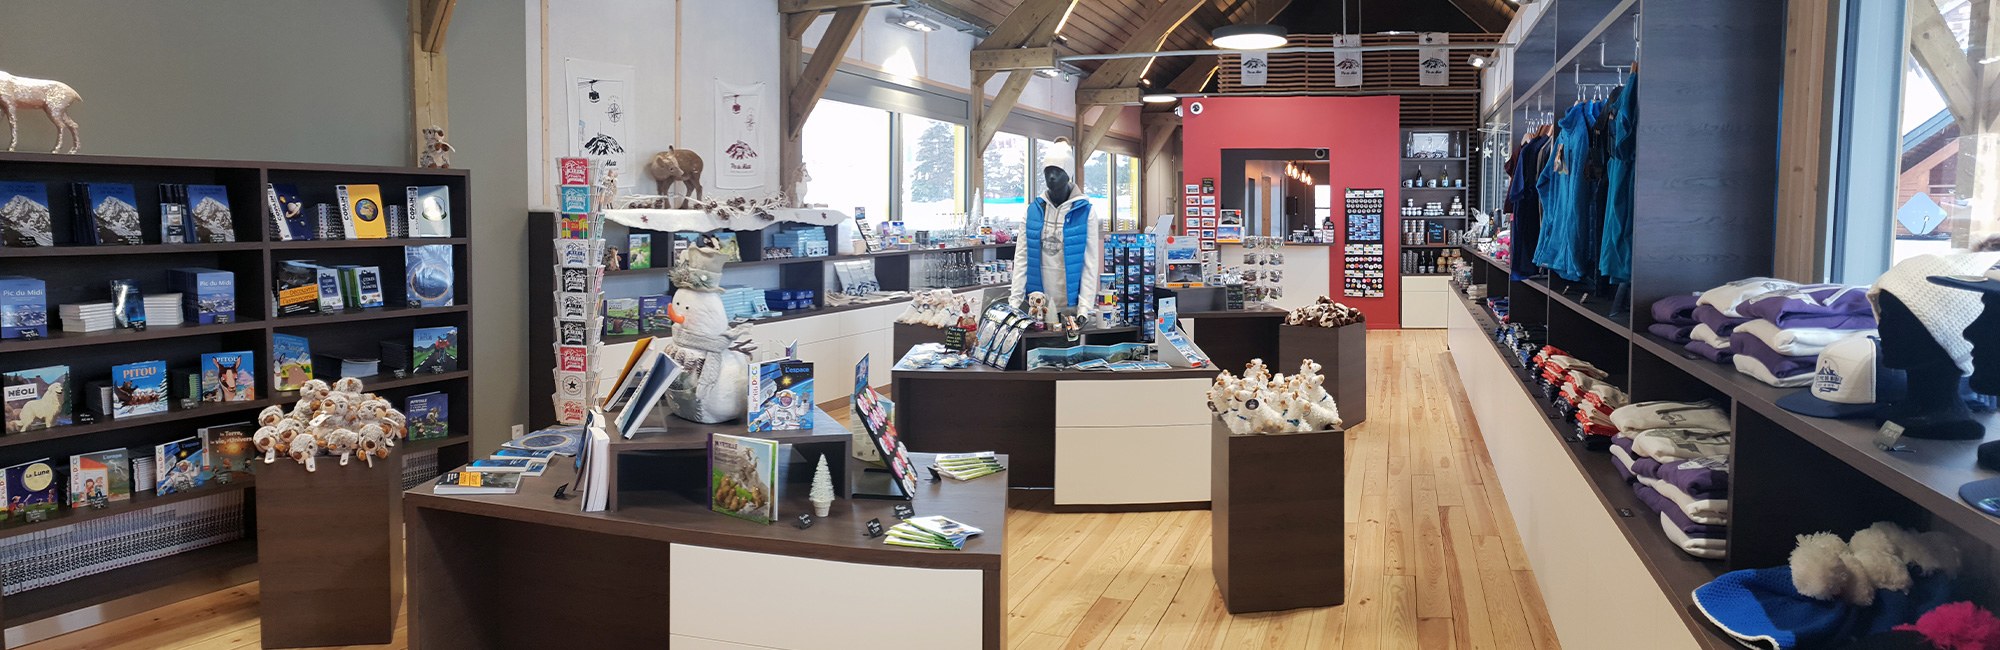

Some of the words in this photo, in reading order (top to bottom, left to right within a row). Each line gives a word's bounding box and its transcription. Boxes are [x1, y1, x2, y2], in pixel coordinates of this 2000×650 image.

[3, 289, 14, 297] Pic
[123, 367, 156, 378] PITOU
[785, 366, 810, 374] L'espace
[8, 387, 35, 397] NÉOU
[33, 468, 50, 477] Lune
